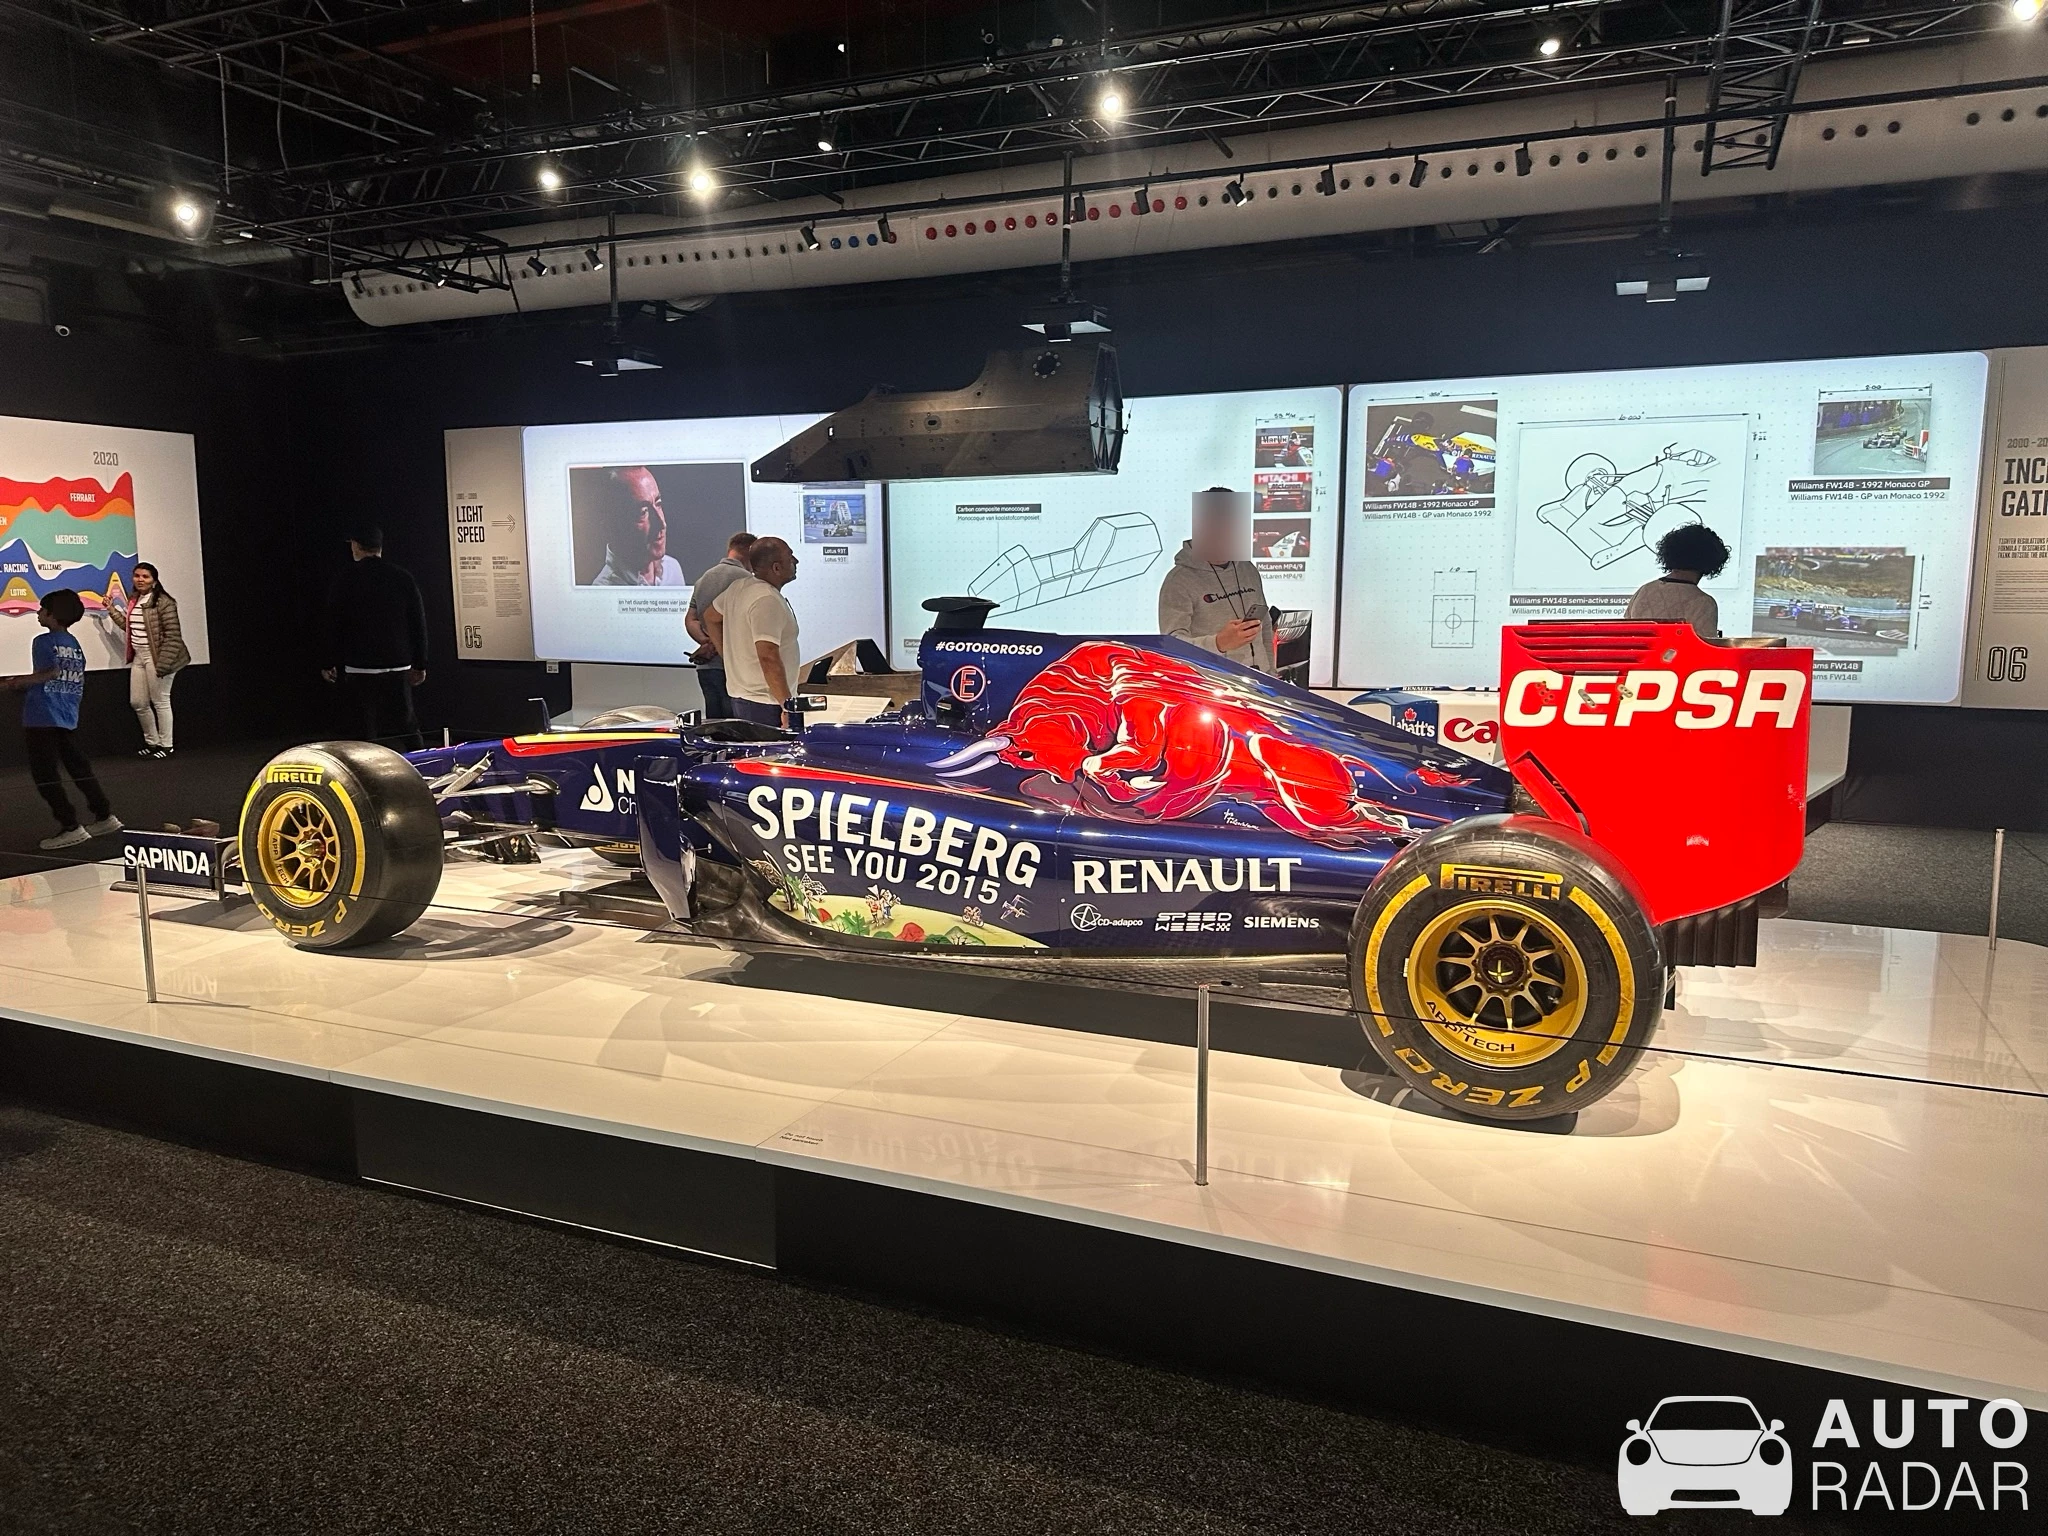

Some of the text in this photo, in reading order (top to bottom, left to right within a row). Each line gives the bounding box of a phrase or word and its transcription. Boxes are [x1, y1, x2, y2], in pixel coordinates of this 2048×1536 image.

[93, 452, 119, 466] 2020
[2003, 457, 2048, 484] INC
[1258, 474, 1299, 483] HITACHI
[1791, 480, 1824, 490] Williams
[1825, 481, 1854, 490] FW14B
[1861, 481, 1883, 489] 1992
[1884, 480, 1916, 489] Monaco
[1917, 480, 1930, 488] GP
[70, 493, 96, 503] FERRARI
[1790, 493, 1823, 501] Williams
[1824, 493, 1853, 501] FW14B
[1890, 492, 1921, 500] Monaco
[1923, 491, 1945, 499] 1992
[456, 505, 484, 523] LIGHT
[975, 505, 1000, 514] composite
[1001, 505, 1030, 514] monocoque
[1364, 503, 1392, 511] Williams
[55, 534, 89, 545] MERCEDES
[457, 526, 486, 543] SPEED
[3, 564, 29, 573] RACING
[38, 563, 62, 571] WILLIAMS
[1257, 563, 1304, 571] McLaren MP4/9
[10, 588, 27, 597] LOTUS
[1202, 587, 1256, 604] Champion
[1512, 597, 1541, 605] Williams
[1568, 597, 1609, 605] semi-active
[1511, 607, 1541, 615] Williams
[1541, 607, 1567, 615] FW14B
[464, 625, 484, 649] 05
[935, 641, 1044, 656] #GOTOROROSSO
[1830, 662, 1859, 670] FW14B
[1987, 646, 2029, 682] 06
[1829, 673, 1858, 681] FW14B
[1503, 669, 1807, 729] CEPSA
[266, 764, 325, 785] PIRELLI
[747, 784, 1042, 889] SPIELBERG
[123, 844, 210, 877] SAPINDA
[783, 844, 1002, 905] SEE YOU 2015
[1071, 857, 1302, 894] RENAULT
[1440, 863, 1565, 901] PIRELLI
[257, 901, 327, 938] ZERO
[1156, 912, 1232, 922] SPEED
[1243, 915, 1320, 930] SIEMENS
[1154, 922, 1217, 932] WEEK
[1462, 1033, 1516, 1052] TECH
[1394, 1047, 1545, 1109] ZERO
